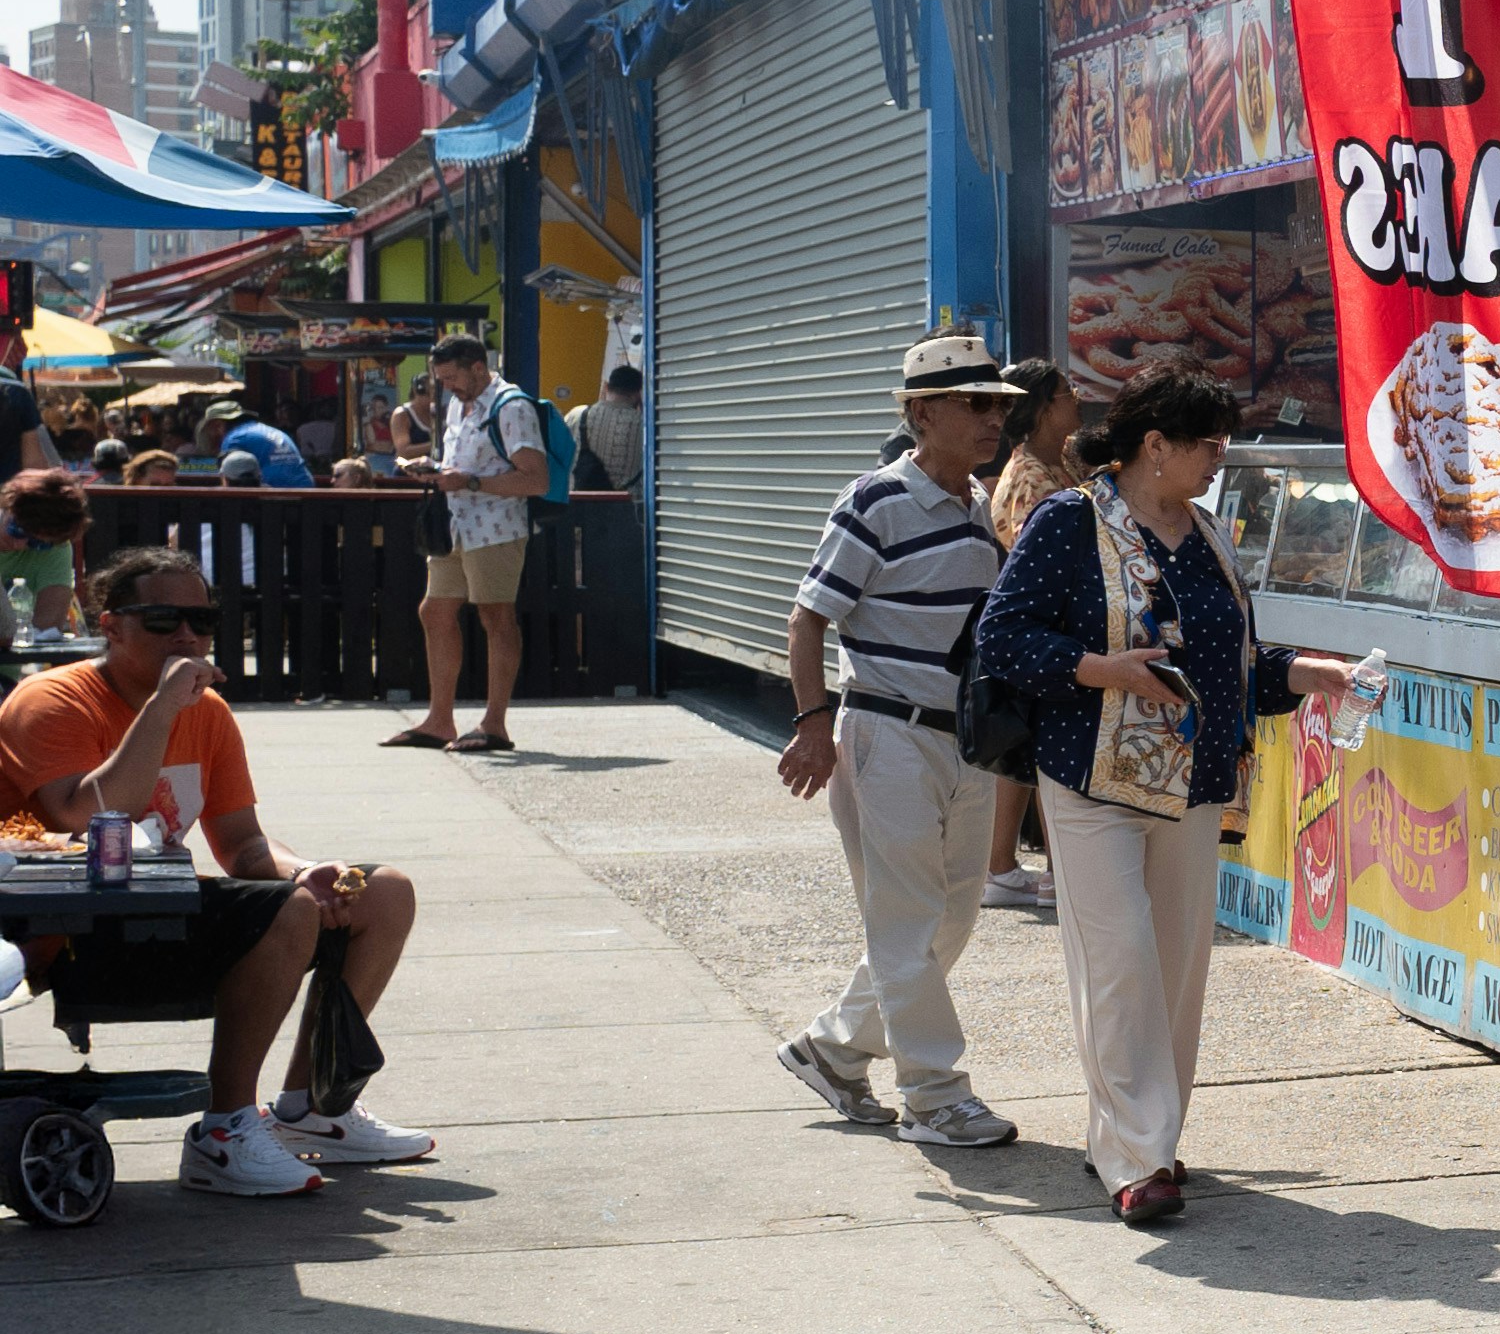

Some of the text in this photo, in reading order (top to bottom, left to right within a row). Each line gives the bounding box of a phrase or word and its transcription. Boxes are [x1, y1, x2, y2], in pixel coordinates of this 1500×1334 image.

[1103, 230, 1218, 260] Funnel Cake
[1352, 782, 1462, 857] COLD BEER
[1383, 833, 1438, 894] SODA
[1352, 920, 1384, 967] HOT
